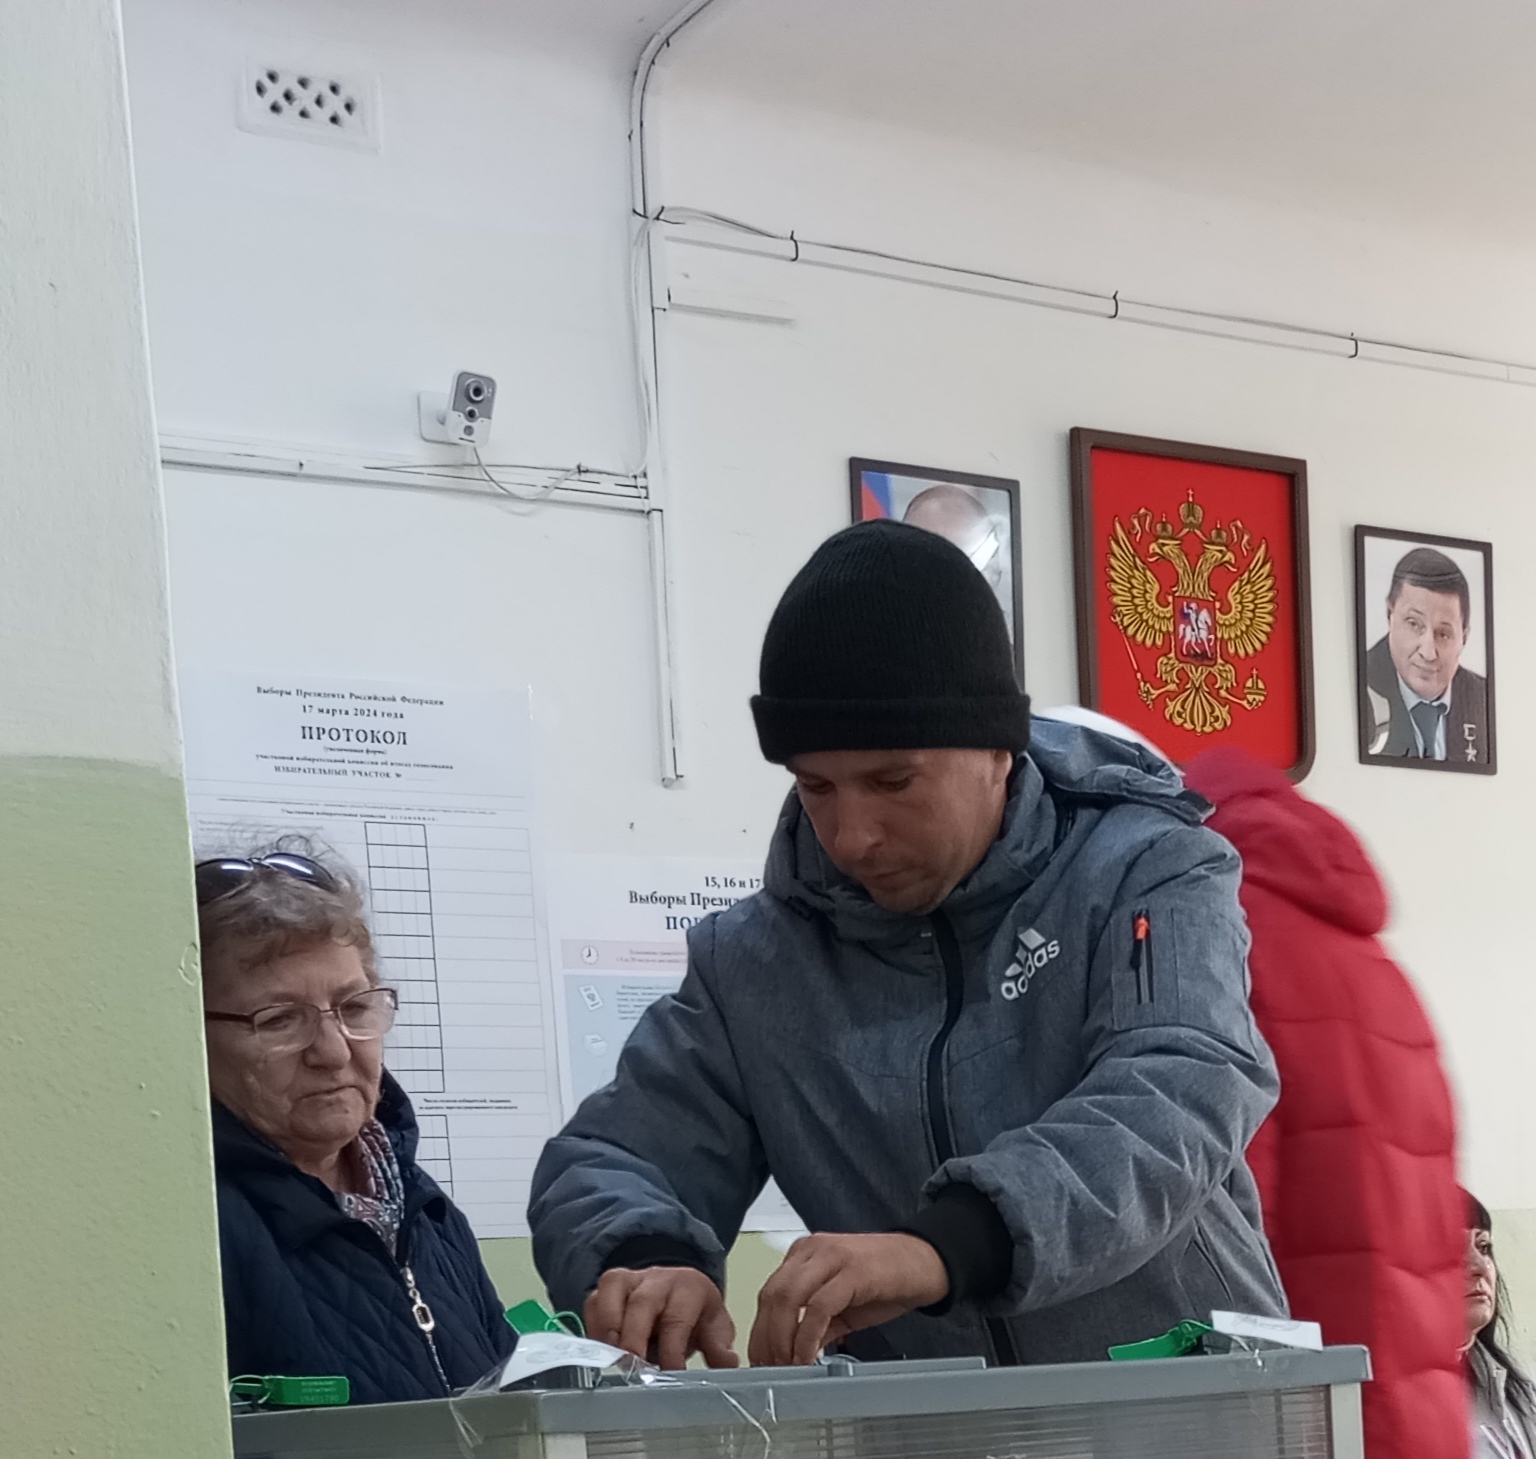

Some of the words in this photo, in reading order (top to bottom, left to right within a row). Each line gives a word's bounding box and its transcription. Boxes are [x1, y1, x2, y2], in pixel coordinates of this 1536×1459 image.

[256, 686, 292, 698] Выборы
[296, 688, 345, 701] Президента
[349, 691, 397, 703] Российской
[400, 694, 445, 706] Федерации
[301, 704, 314, 714] 17
[317, 707, 350, 718] марта
[353, 707, 379, 718] 2024
[381, 710, 405, 720] года
[300, 725, 408, 746] ПРОТОКОЛ
[274, 765, 348, 776] ИЗБИРАТЕЛЬНЫЙ
[351, 769, 392, 779] УЧАСТОК
[705, 876, 721, 889] 15,
[724, 877, 736, 888] 16
[749, 878, 761, 889] 17
[629, 890, 687, 909] Выборы
